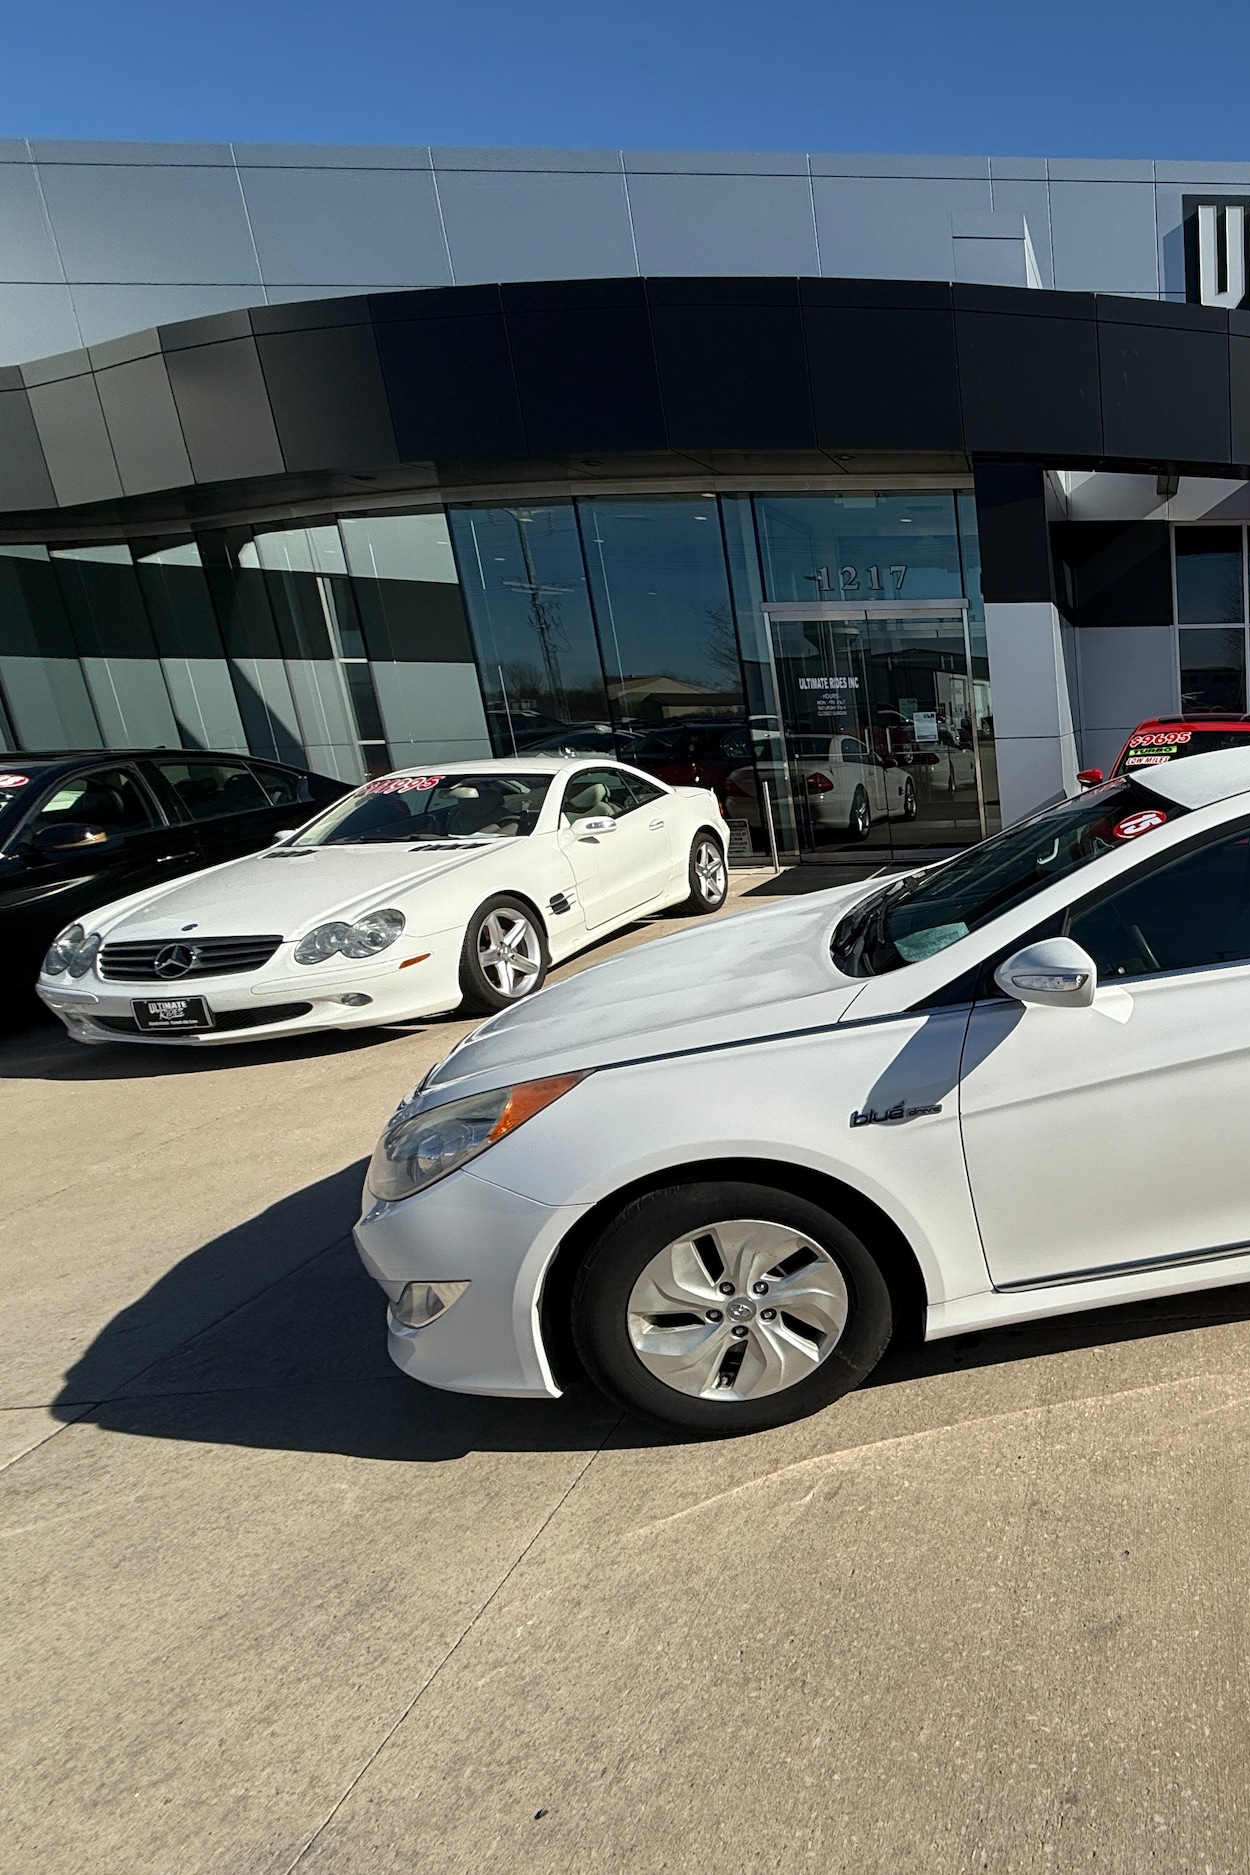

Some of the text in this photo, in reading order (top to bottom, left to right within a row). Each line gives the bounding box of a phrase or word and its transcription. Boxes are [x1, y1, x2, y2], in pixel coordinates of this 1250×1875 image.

[816, 564, 909, 593] 1217
[798, 677, 859, 689] ULTIMATE RIDES INC
[1129, 731, 1192, 748] $9695
[1133, 747, 1174, 755] TURBO
[1127, 757, 1143, 766] LOW
[147, 1001, 188, 1015] ULTIMATE
[850, 1103, 942, 1128] blue drive
